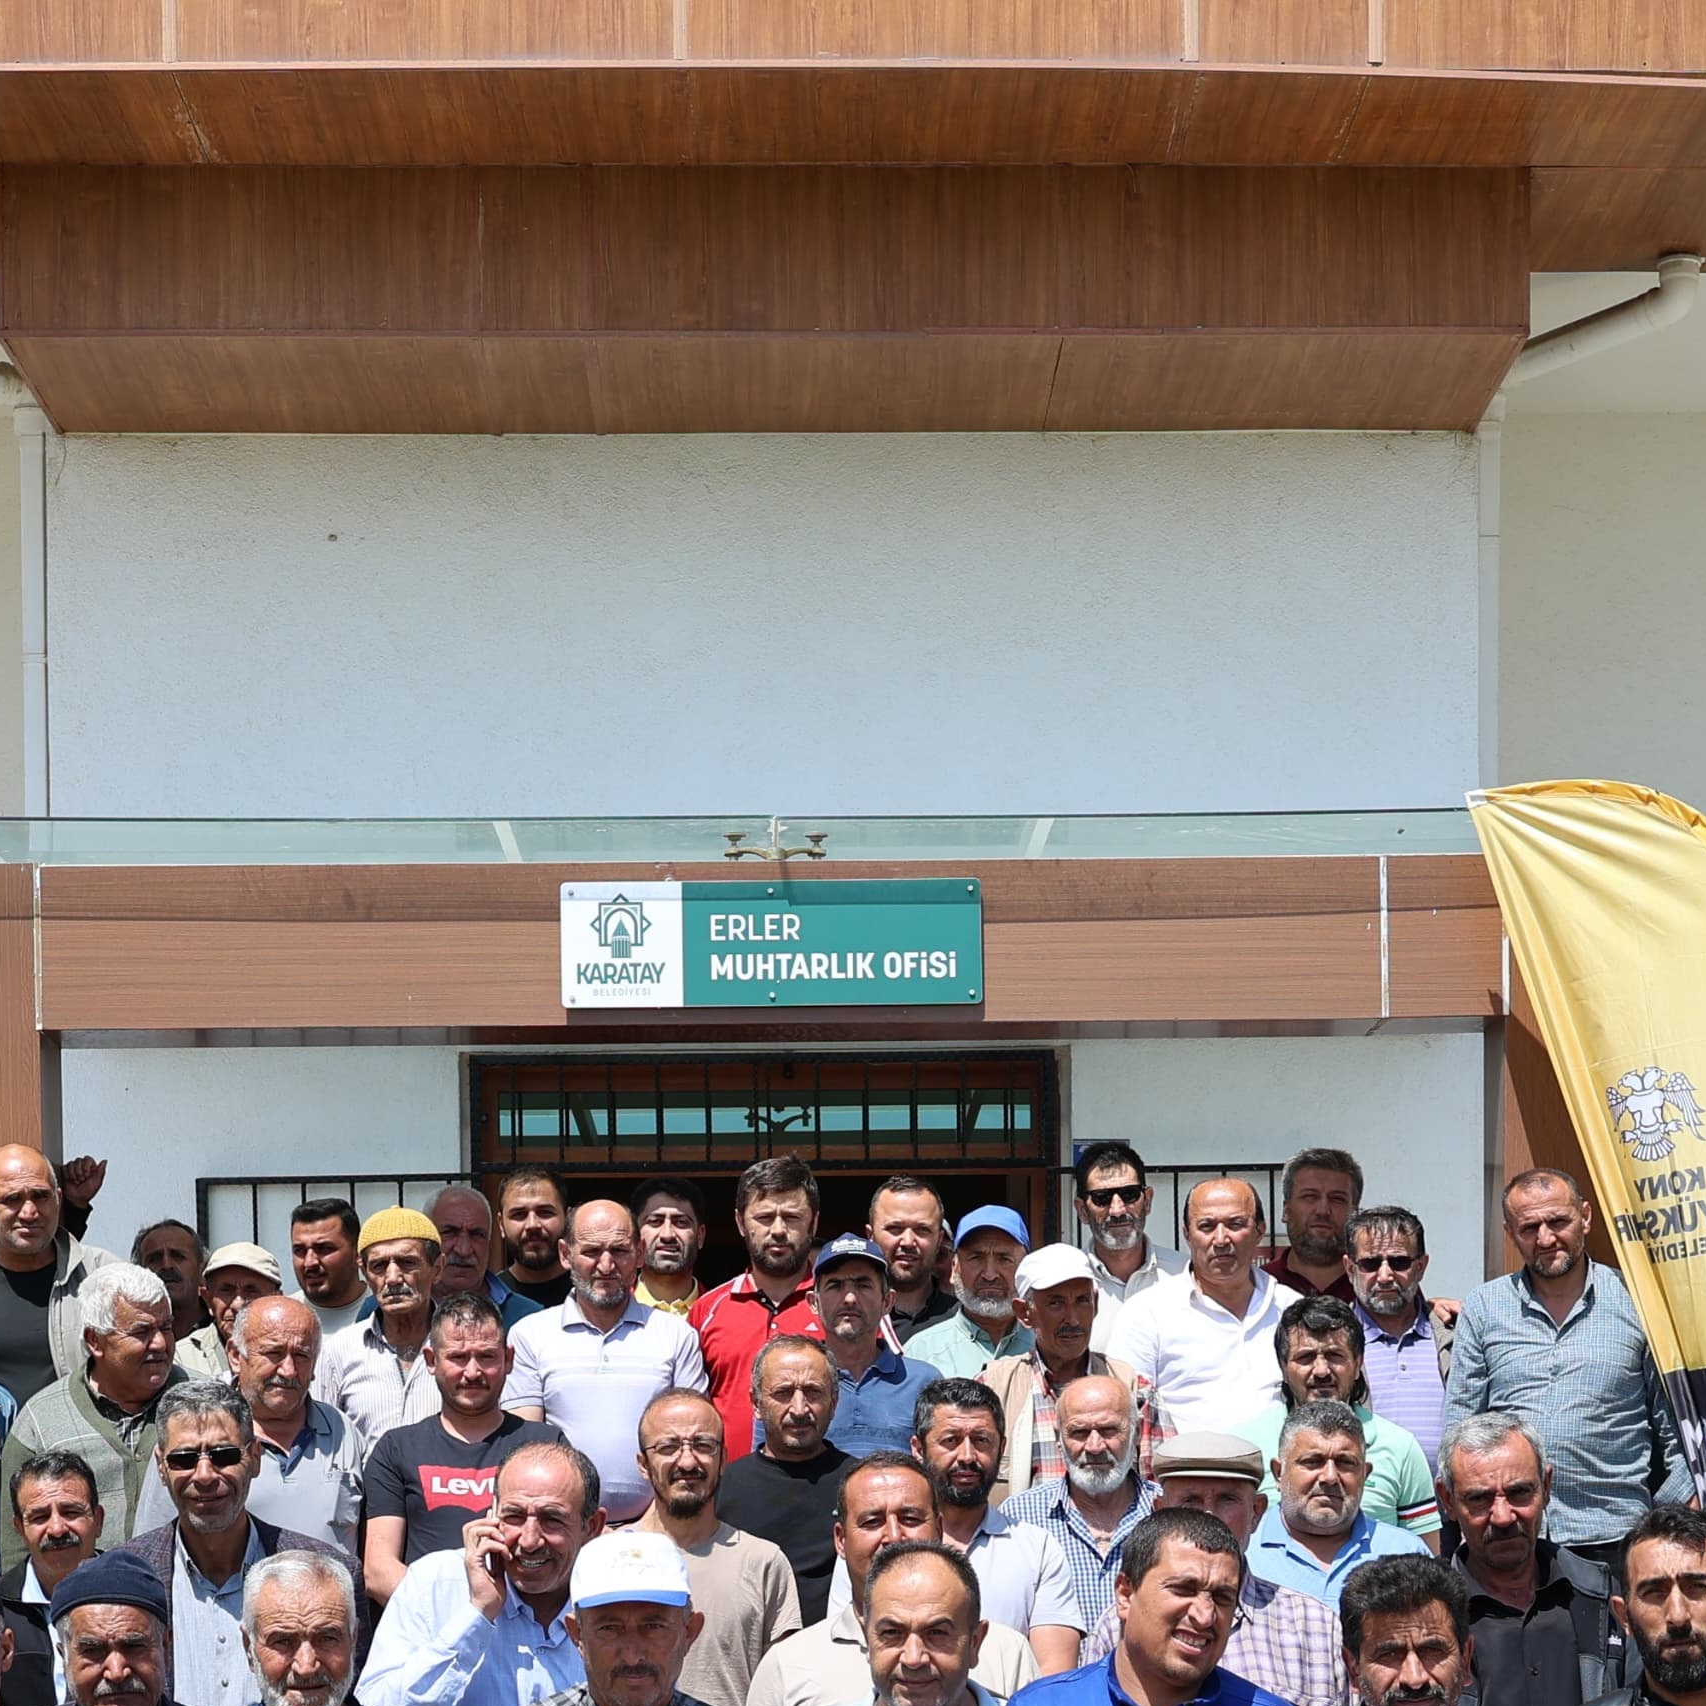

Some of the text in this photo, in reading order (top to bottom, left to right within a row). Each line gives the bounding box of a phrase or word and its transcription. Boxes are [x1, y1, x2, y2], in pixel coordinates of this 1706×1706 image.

[710, 914, 801, 941] ERLER
[576, 962, 666, 984] KARATAY
[710, 952, 875, 980] MUHTARLIK
[432, 1476, 495, 1496] Levi
